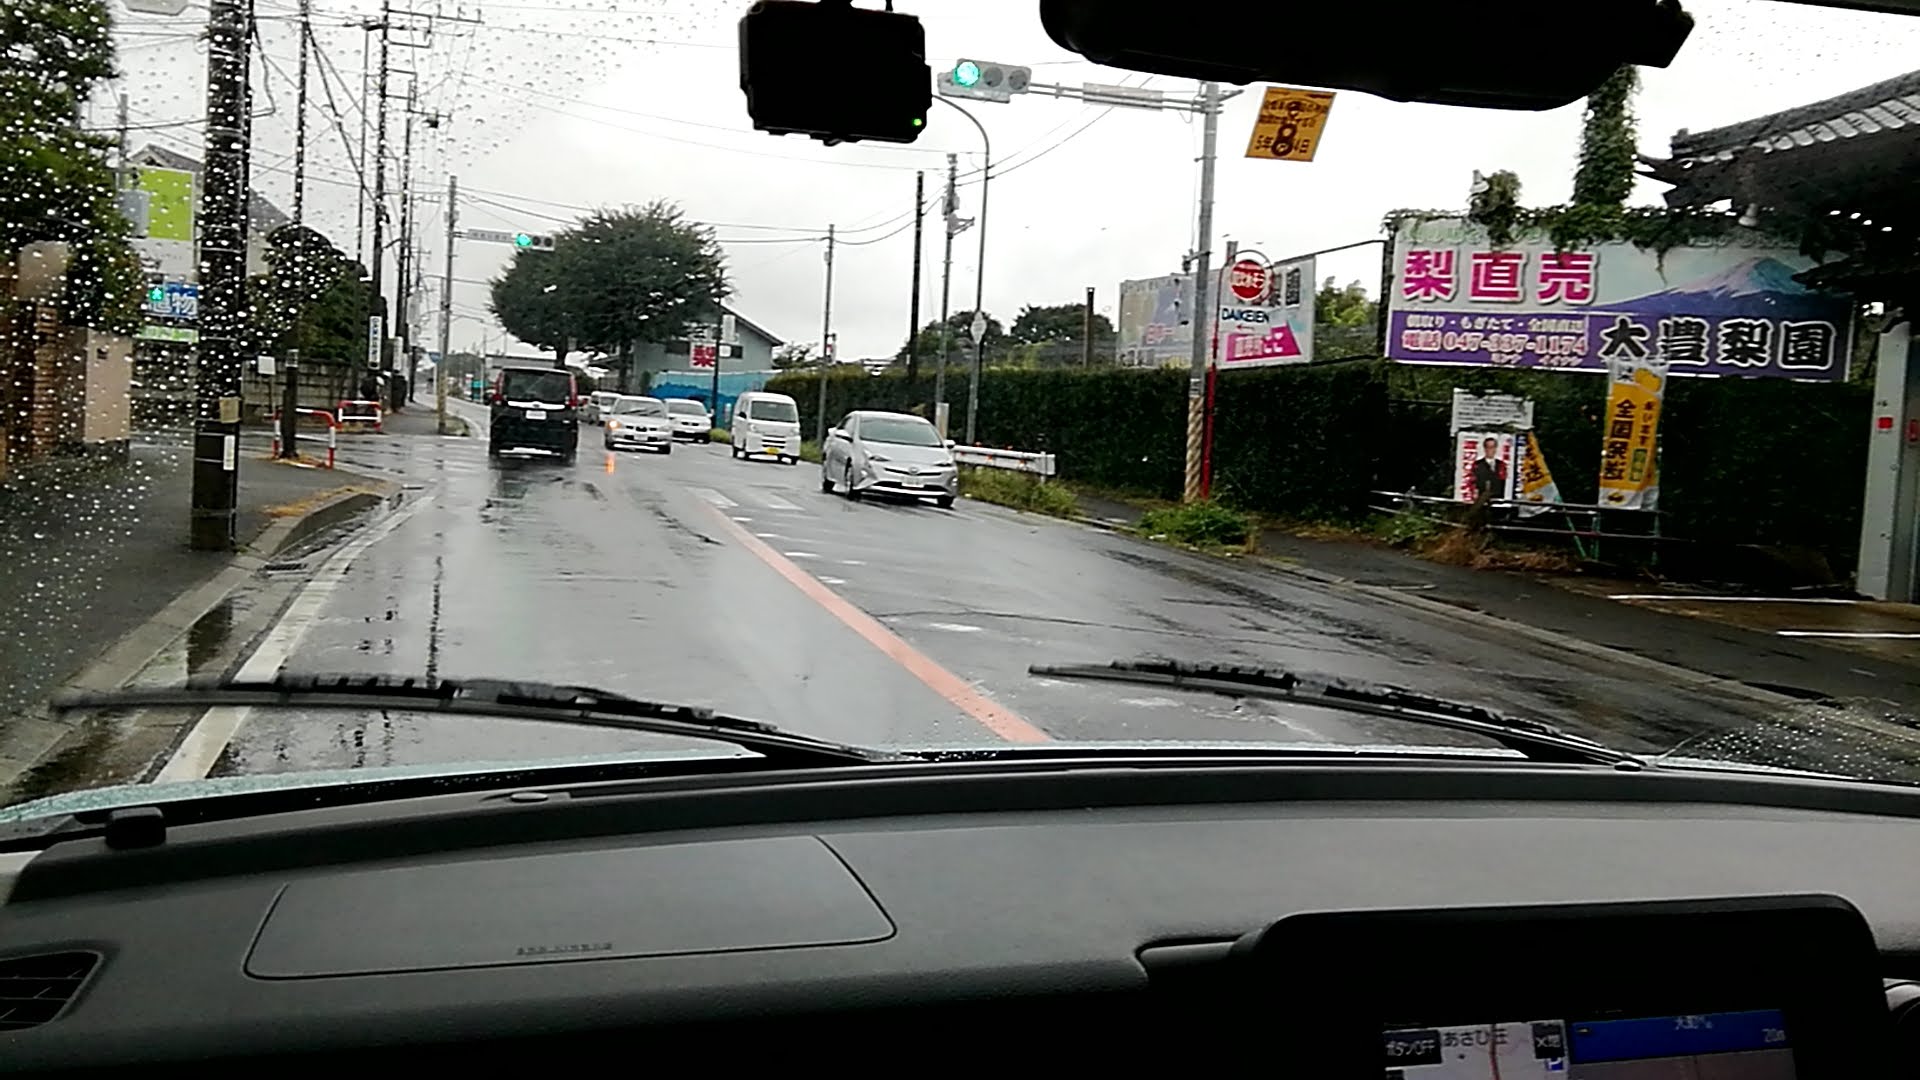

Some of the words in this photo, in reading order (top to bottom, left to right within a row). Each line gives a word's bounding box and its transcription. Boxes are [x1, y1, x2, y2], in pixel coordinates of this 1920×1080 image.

[1402, 249, 1594, 303] 梨直売
[1598, 315, 1836, 369] 大豊梨園
